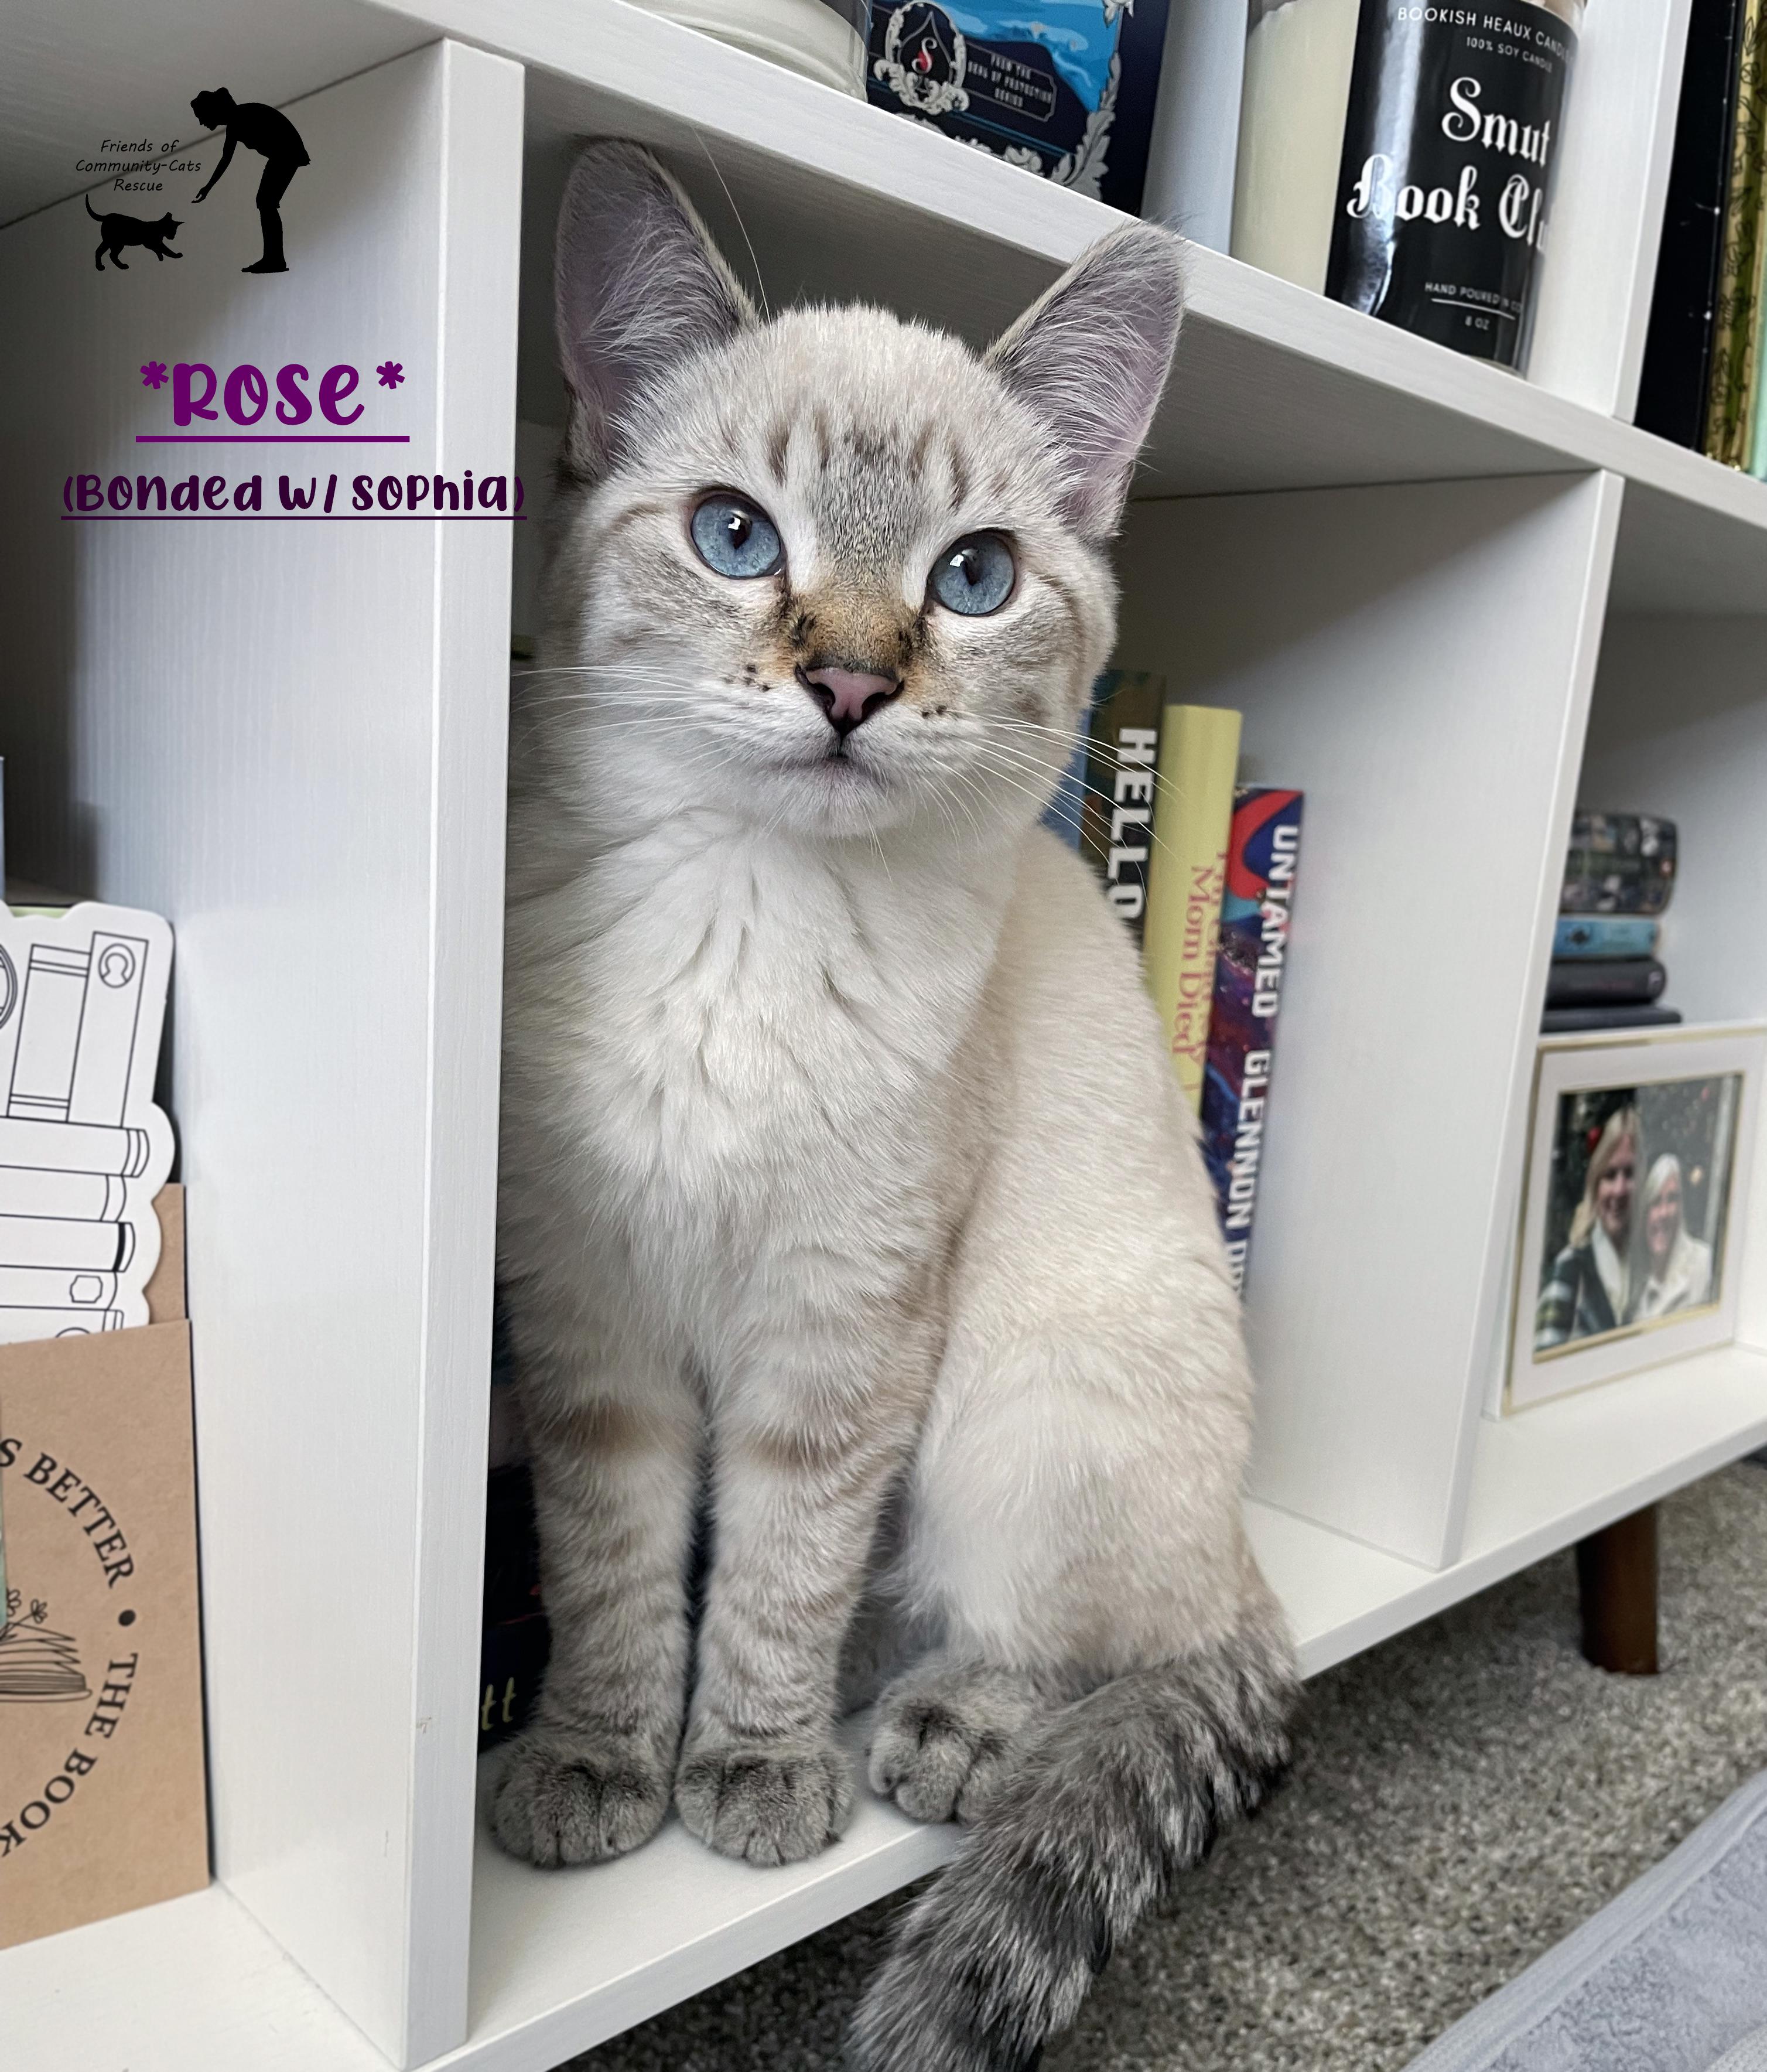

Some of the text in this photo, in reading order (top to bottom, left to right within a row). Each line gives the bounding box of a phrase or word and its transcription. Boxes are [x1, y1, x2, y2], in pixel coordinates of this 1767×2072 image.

[1398, 7, 1476, 26] BOOKISH
[1484, 15, 1532, 40] HEAUX
[1467, 36, 1493, 51] 100%
[1498, 43, 1519, 57] SOY
[1441, 77, 1551, 169] Smut
[1346, 153, 1481, 230] Book
[1425, 282, 1457, 295] HAND
[1460, 286, 1501, 305] POURED
[1475, 317, 1491, 330] OZ
[1107, 728, 1158, 919] HELLO
[1182, 864, 1214, 960] Mom
[1251, 825, 1298, 1018] UNTAMED
[1172, 971, 1202, 1054] Died
[1226, 1050, 1270, 1230] GLENNON
[23, 1451, 134, 1589] BETTER
[0, 1652, 138, 1858] THE BOOK
